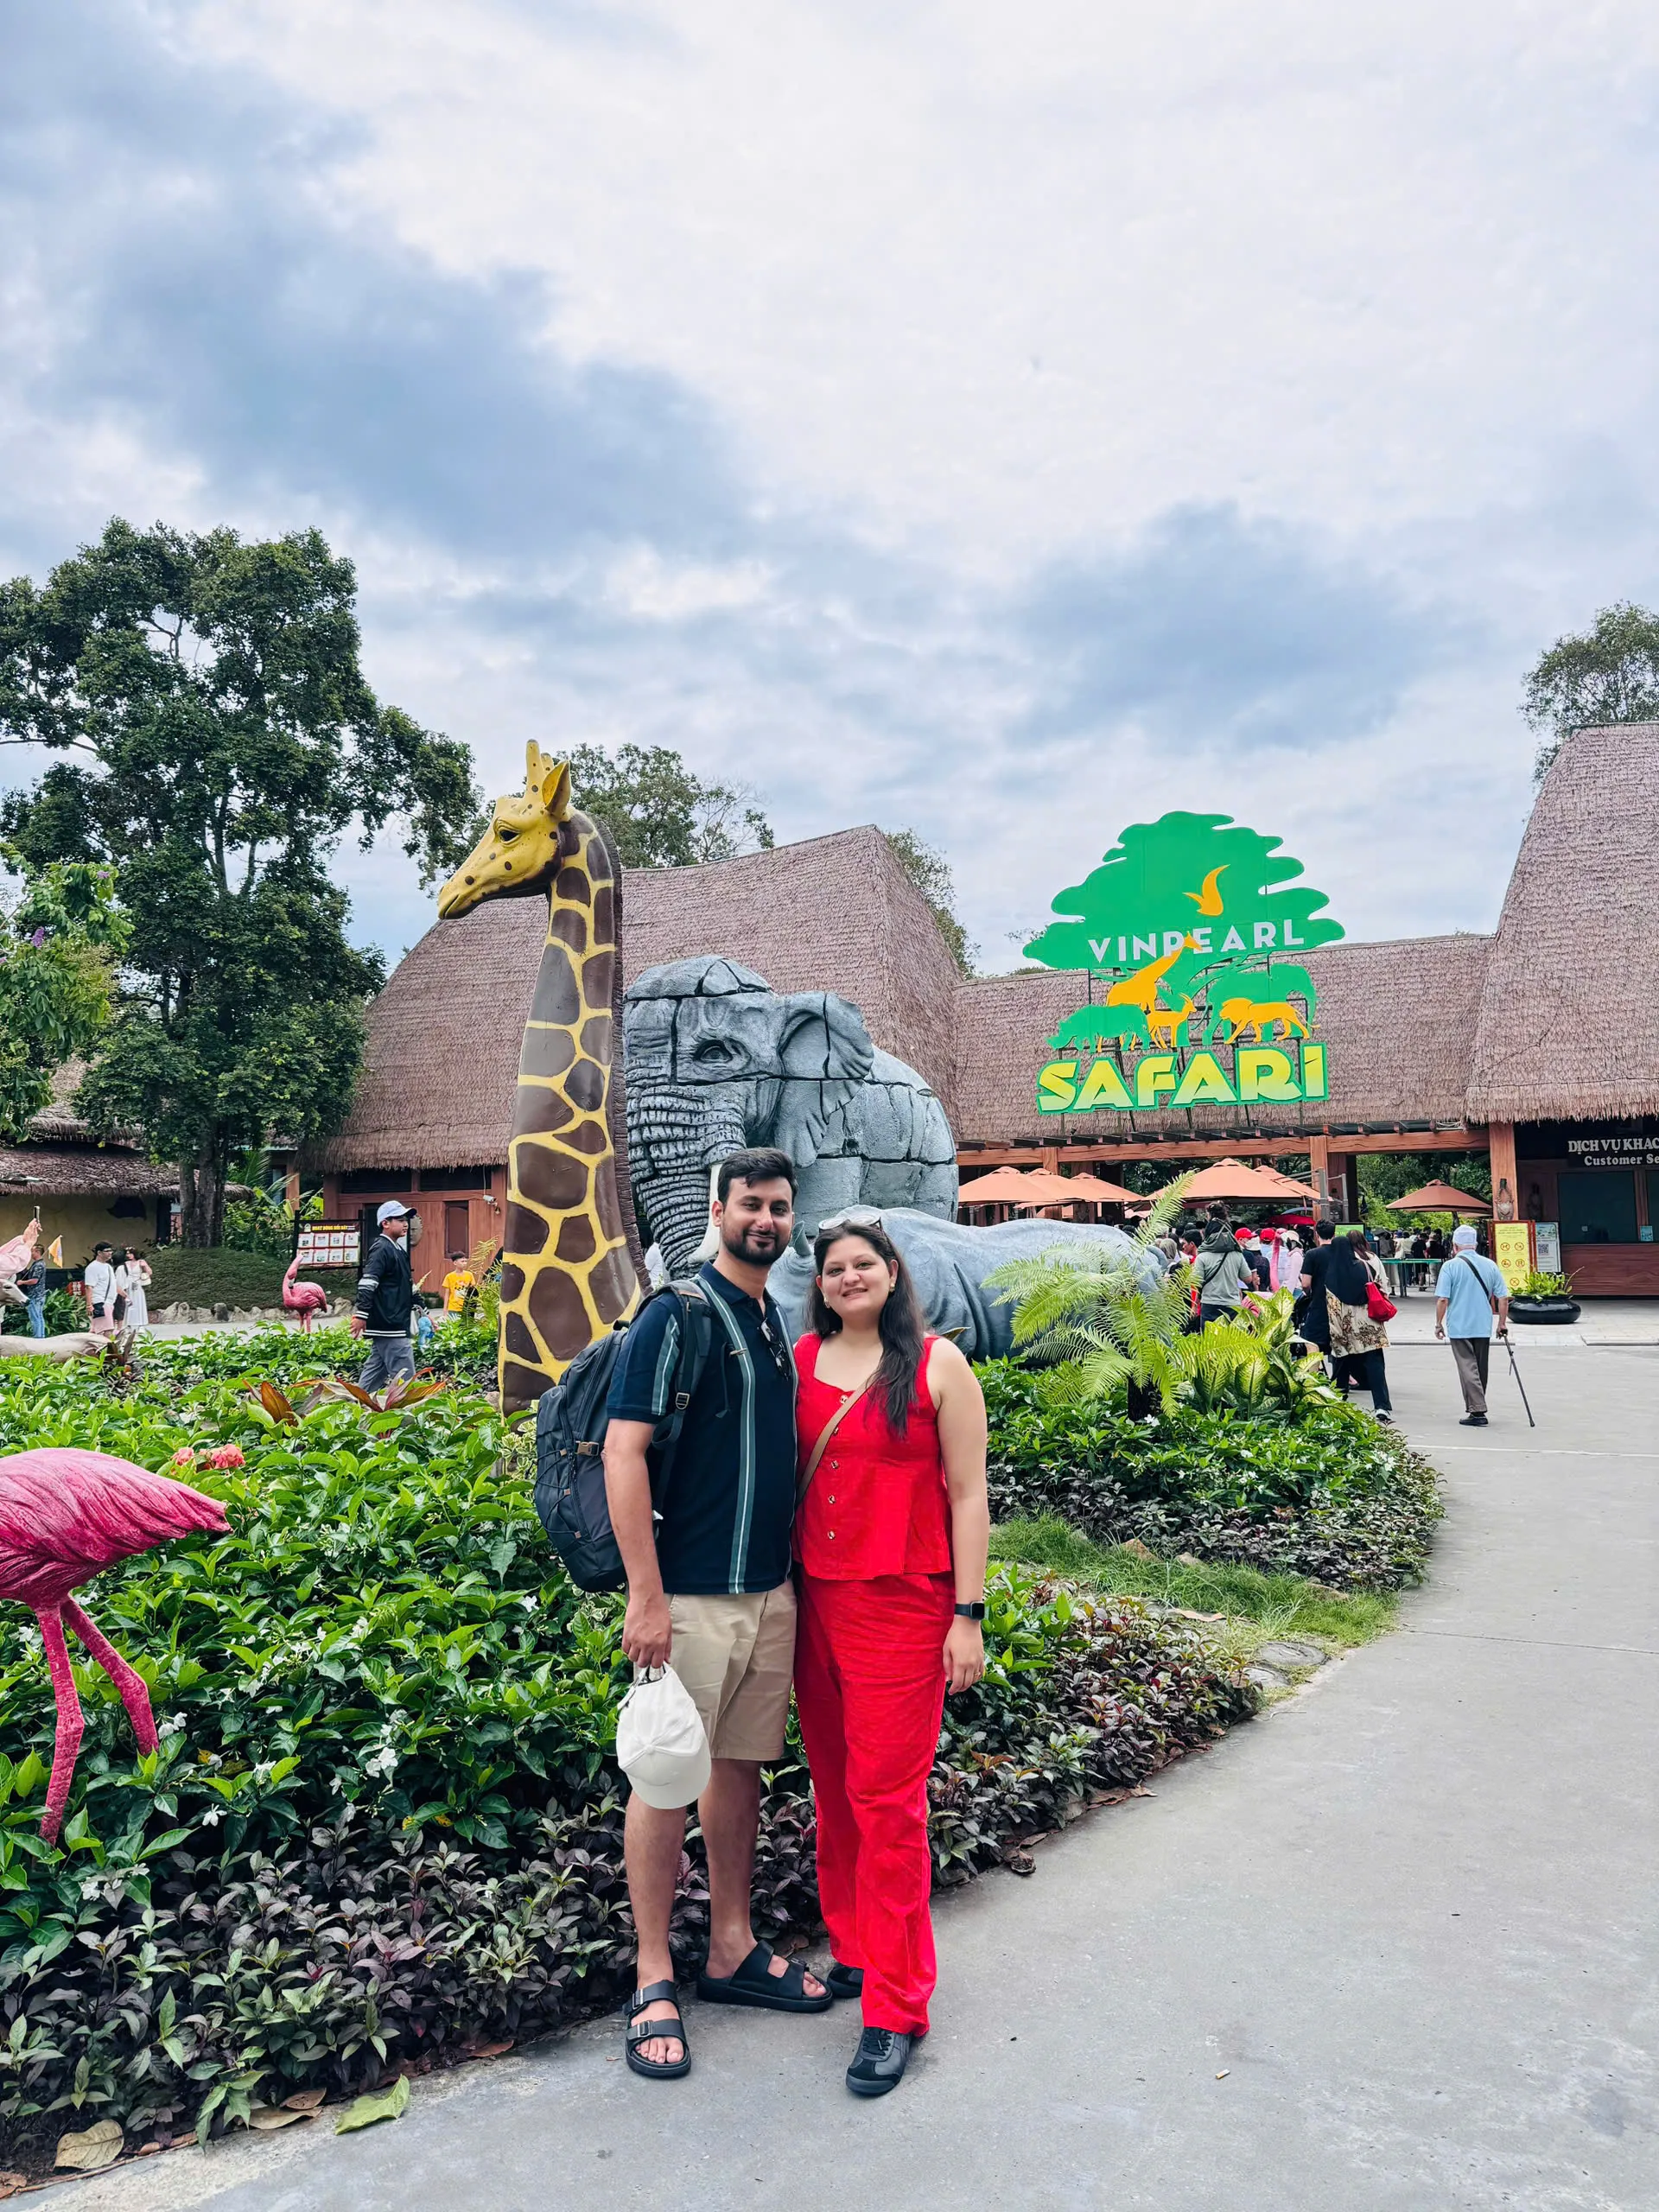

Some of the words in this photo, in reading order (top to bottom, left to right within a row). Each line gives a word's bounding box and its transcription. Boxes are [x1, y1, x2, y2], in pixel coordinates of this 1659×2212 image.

[1088, 919, 1304, 963] VINPEARL
[1038, 1044, 1327, 1113] SAFARI
[1567, 1140, 1599, 1154] DỊCH
[1600, 1139, 1621, 1154] VỤ
[1584, 1155, 1643, 1166] Customer
